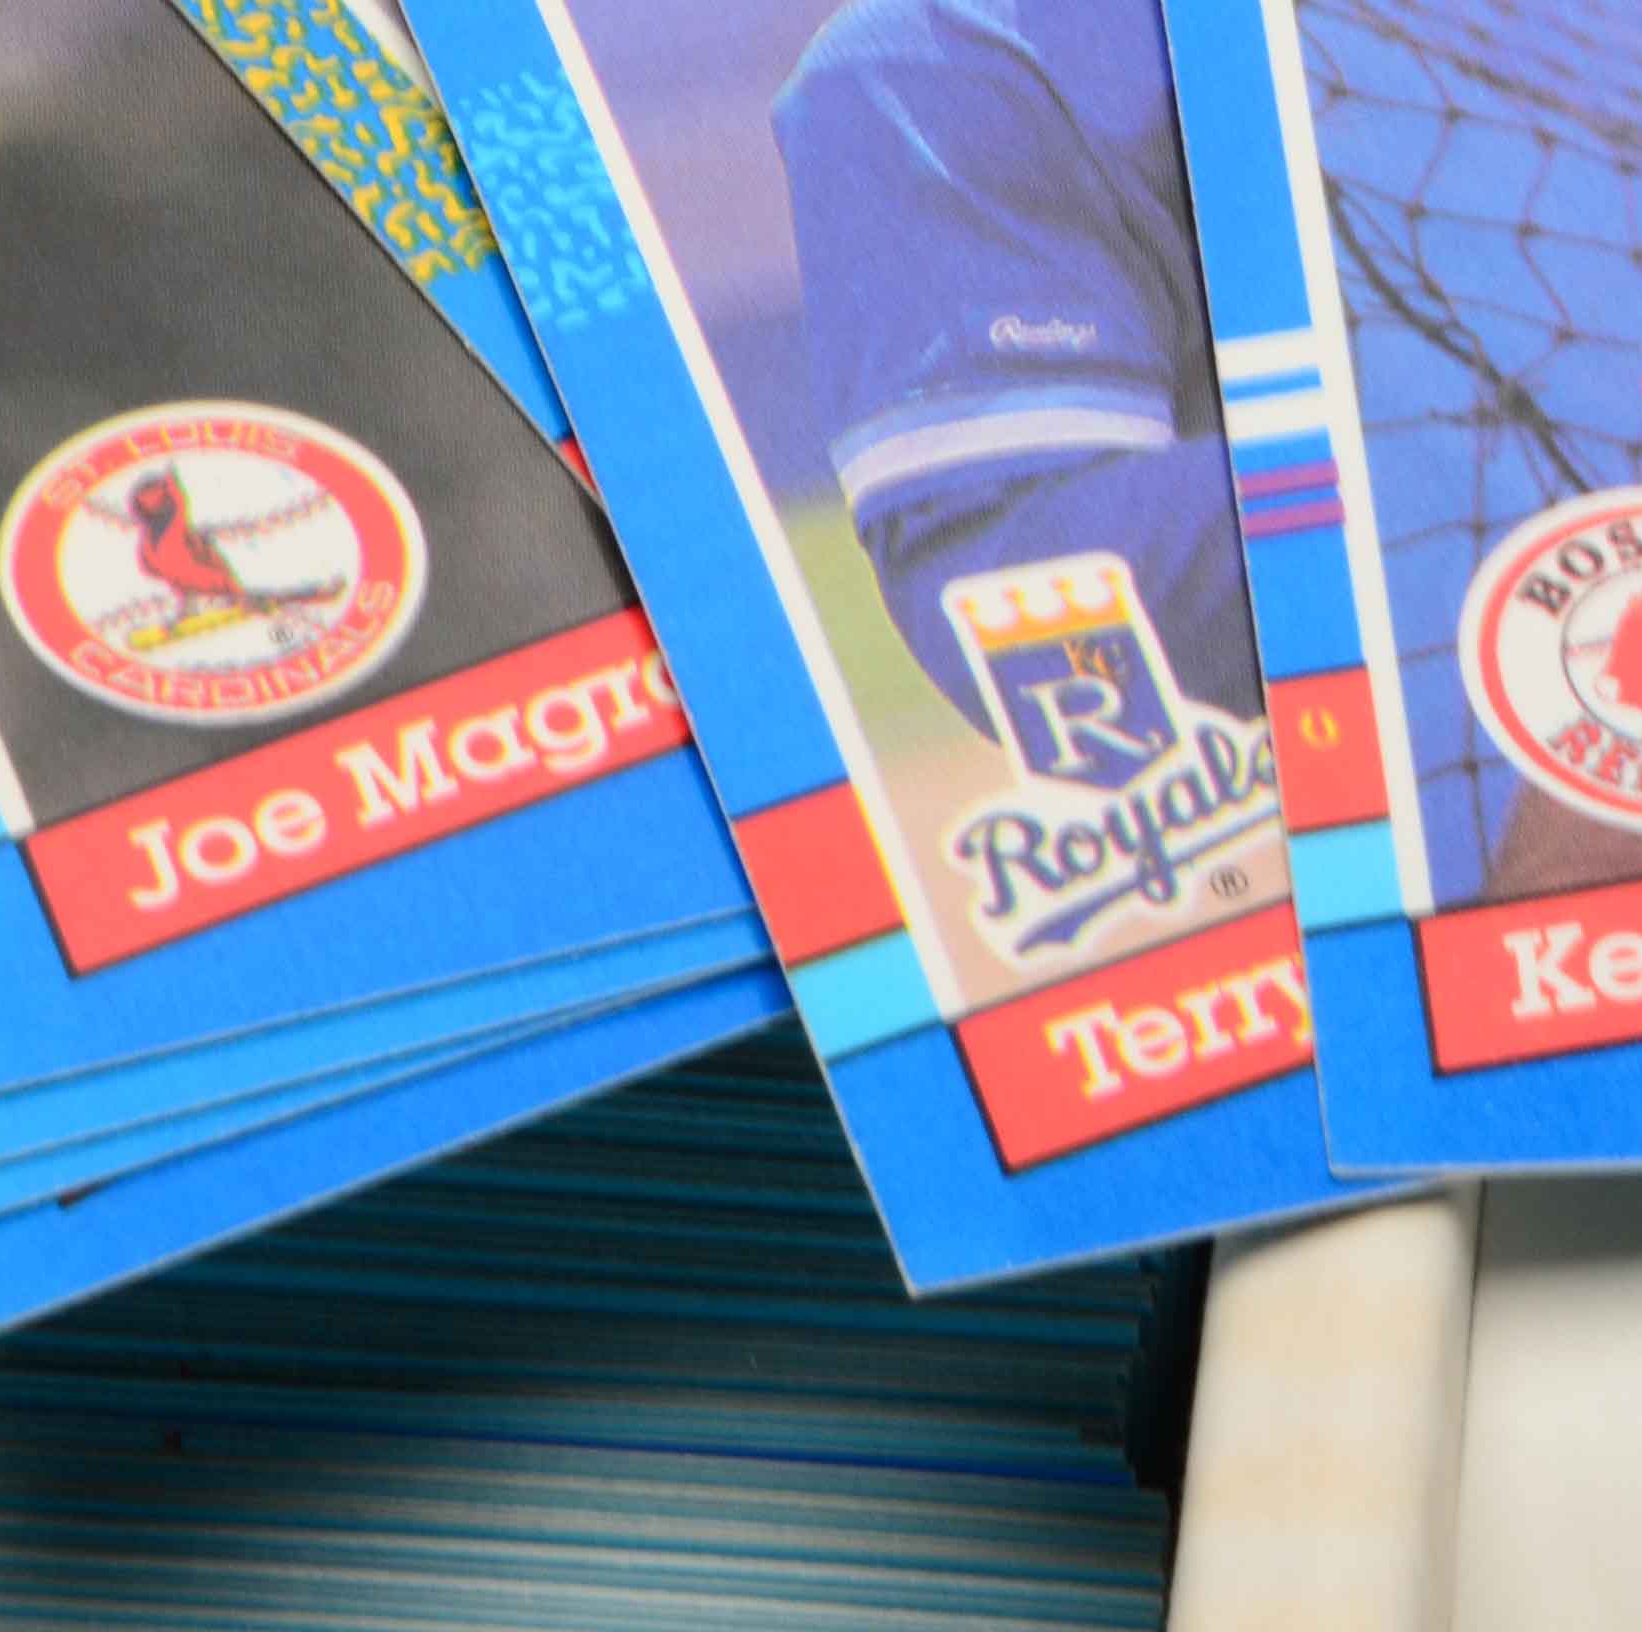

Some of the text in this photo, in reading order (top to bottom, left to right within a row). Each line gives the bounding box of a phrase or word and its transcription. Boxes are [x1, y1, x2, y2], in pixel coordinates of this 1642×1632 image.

[69, 578, 395, 712] CARDINALS
[1017, 674, 1165, 776] R
[127, 786, 329, 913] Joe
